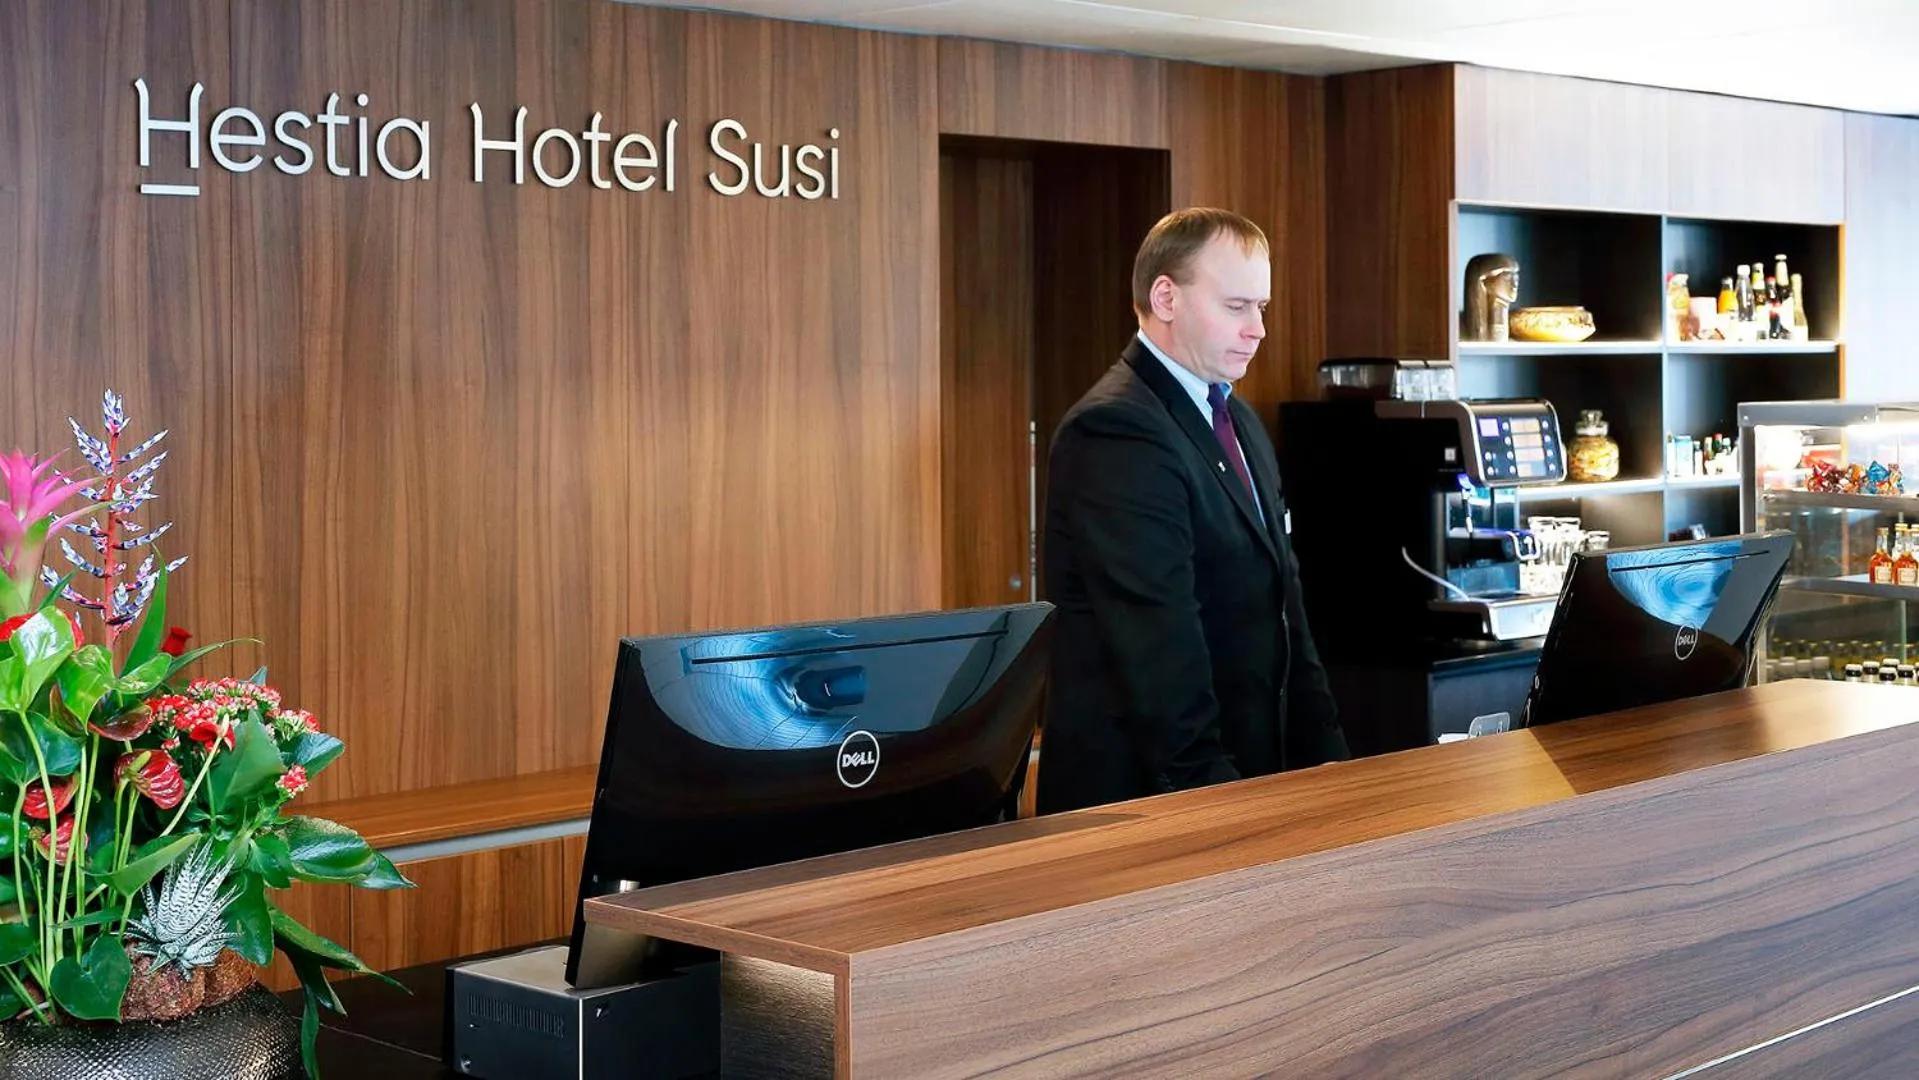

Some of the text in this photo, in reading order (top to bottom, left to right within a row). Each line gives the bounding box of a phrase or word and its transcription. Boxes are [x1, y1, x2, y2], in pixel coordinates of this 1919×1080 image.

[134, 77, 841, 199] Hestia Hotel Susi
[841, 751, 875, 768] DELL
